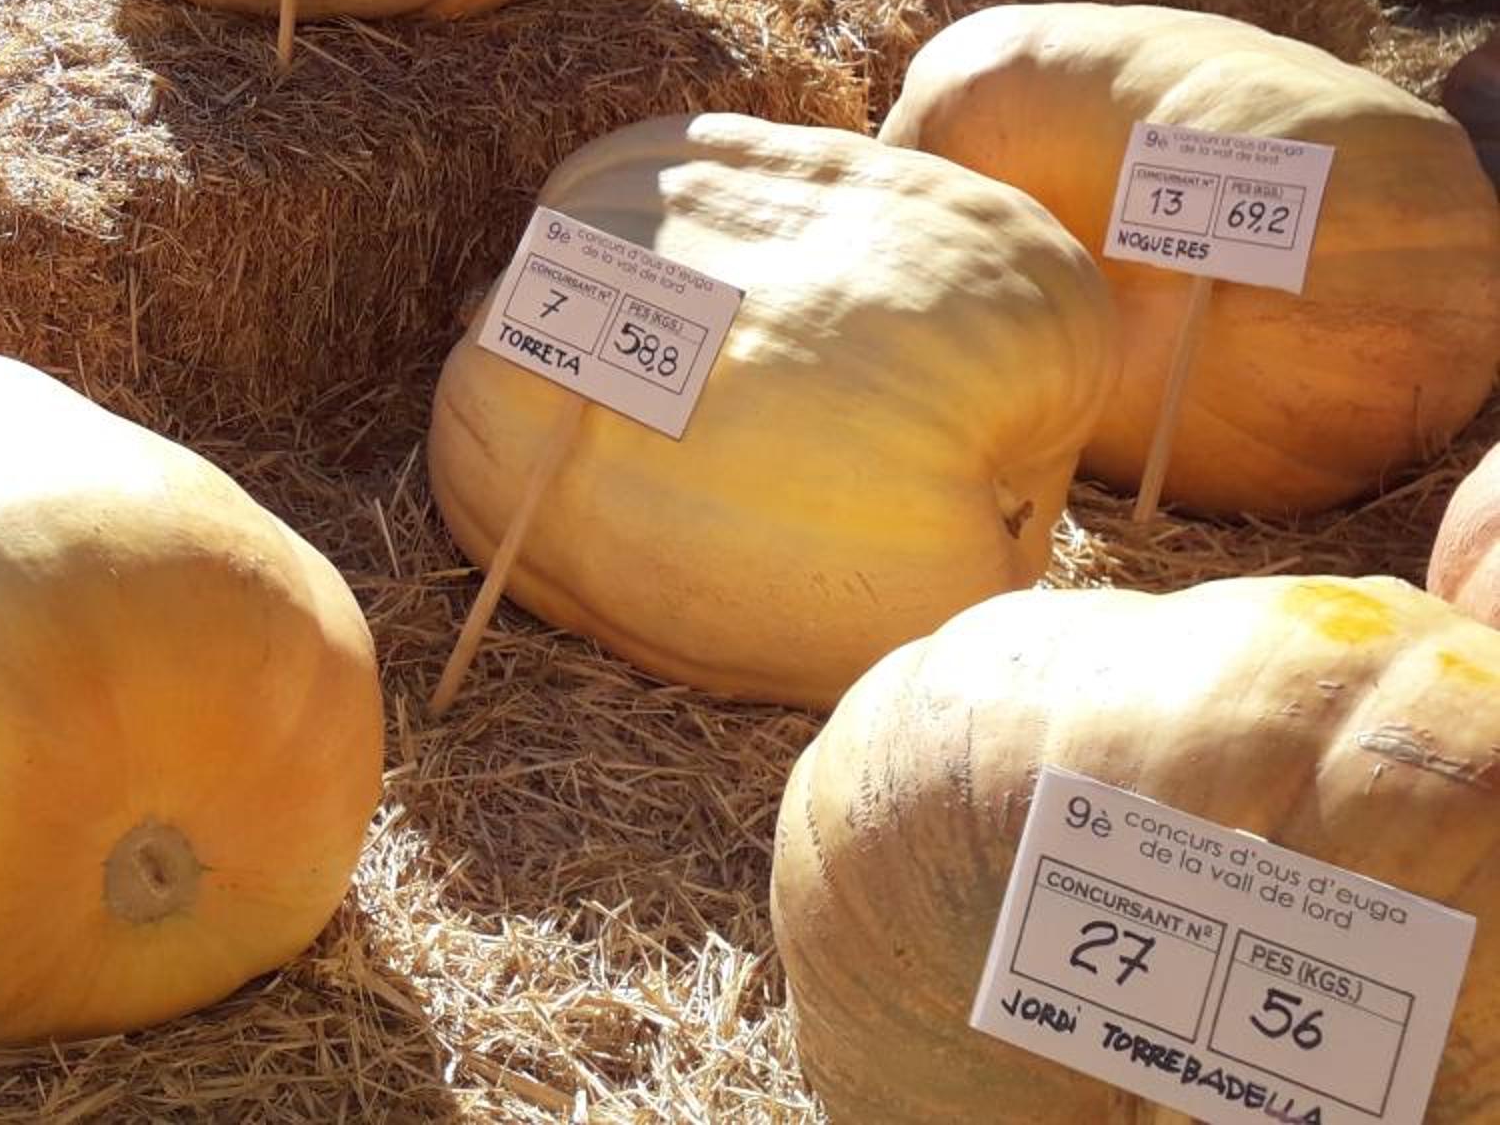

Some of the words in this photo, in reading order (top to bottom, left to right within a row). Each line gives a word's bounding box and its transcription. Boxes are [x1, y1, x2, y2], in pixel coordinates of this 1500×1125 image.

[1151, 186, 1185, 216] 13
[1227, 200, 1290, 235] 69,2
[1118, 229, 1211, 260] NOGUERES
[531, 259, 598, 297] CONCURSANT
[539, 288, 569, 319] 7
[498, 322, 582, 376] TORRETA
[613, 322, 680, 377] 58,8
[1064, 795, 1114, 838] 9è
[1124, 807, 1222, 859] concurs
[1228, 847, 1302, 887] d'ous
[1308, 874, 1409, 926] d'euga
[1139, 838, 1174, 865] de
[1180, 850, 1202, 873] la
[1209, 863, 1255, 894] vall
[1259, 884, 1296, 910] de
[1302, 894, 1353, 931] lord
[1045, 870, 1183, 933] CONCURSANT
[1069, 919, 1157, 987] 27
[1250, 944, 1296, 977] PES
[1297, 959, 1363, 1004] (KGS.)
[1249, 988, 1325, 1051] 56
